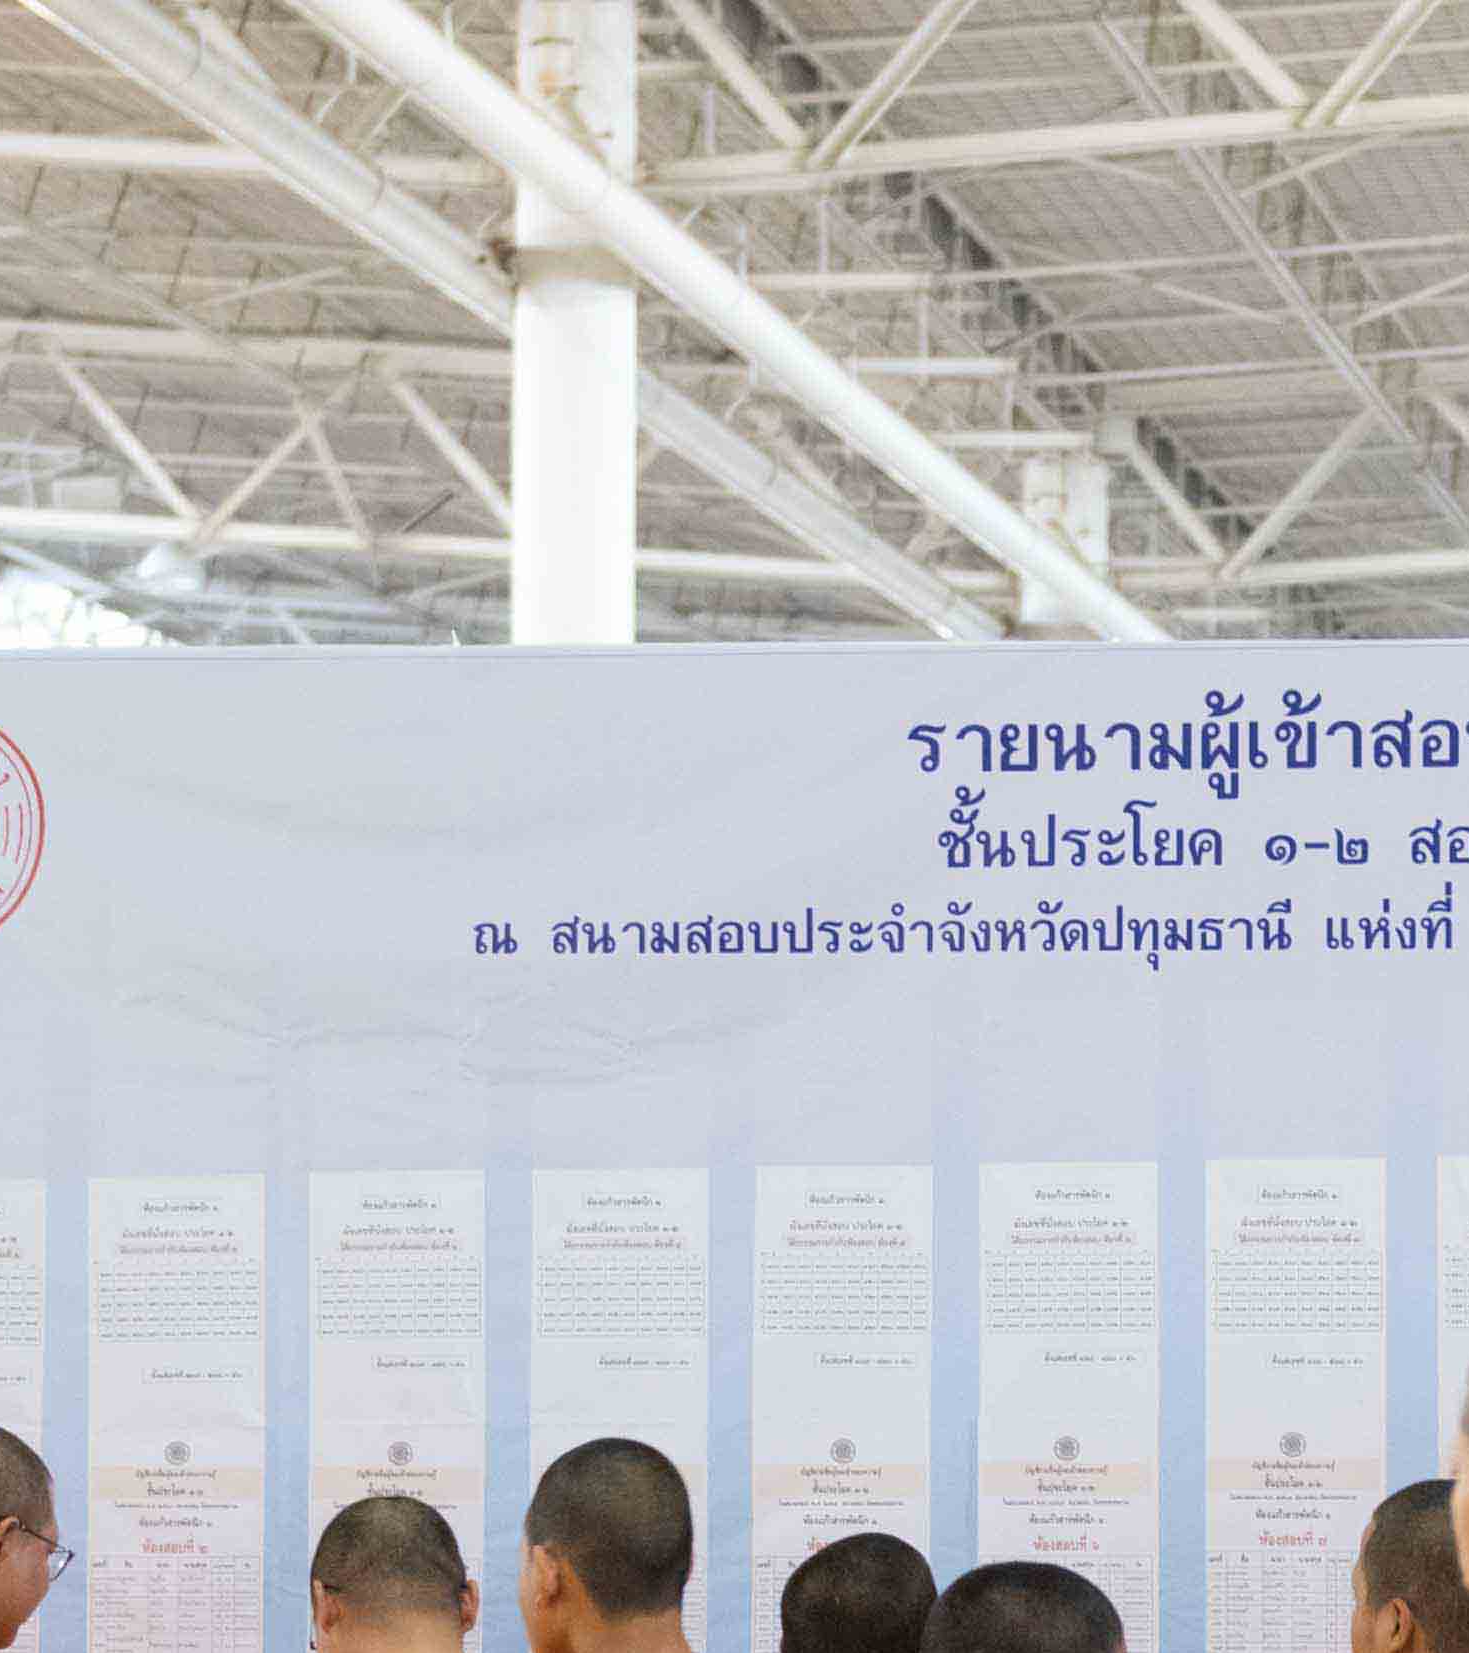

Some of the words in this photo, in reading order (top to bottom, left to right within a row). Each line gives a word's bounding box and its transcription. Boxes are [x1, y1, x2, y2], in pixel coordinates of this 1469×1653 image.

[938, 782, 1226, 868] ชั้นประโยค
[1265, 828, 1369, 865] ๑-๒
[474, 923, 518, 954] ณ
[552, 898, 1292, 971] สนามสอบประจำจังหวัดปทุมธานี
[1326, 881, 1452, 949] แห่งที่
